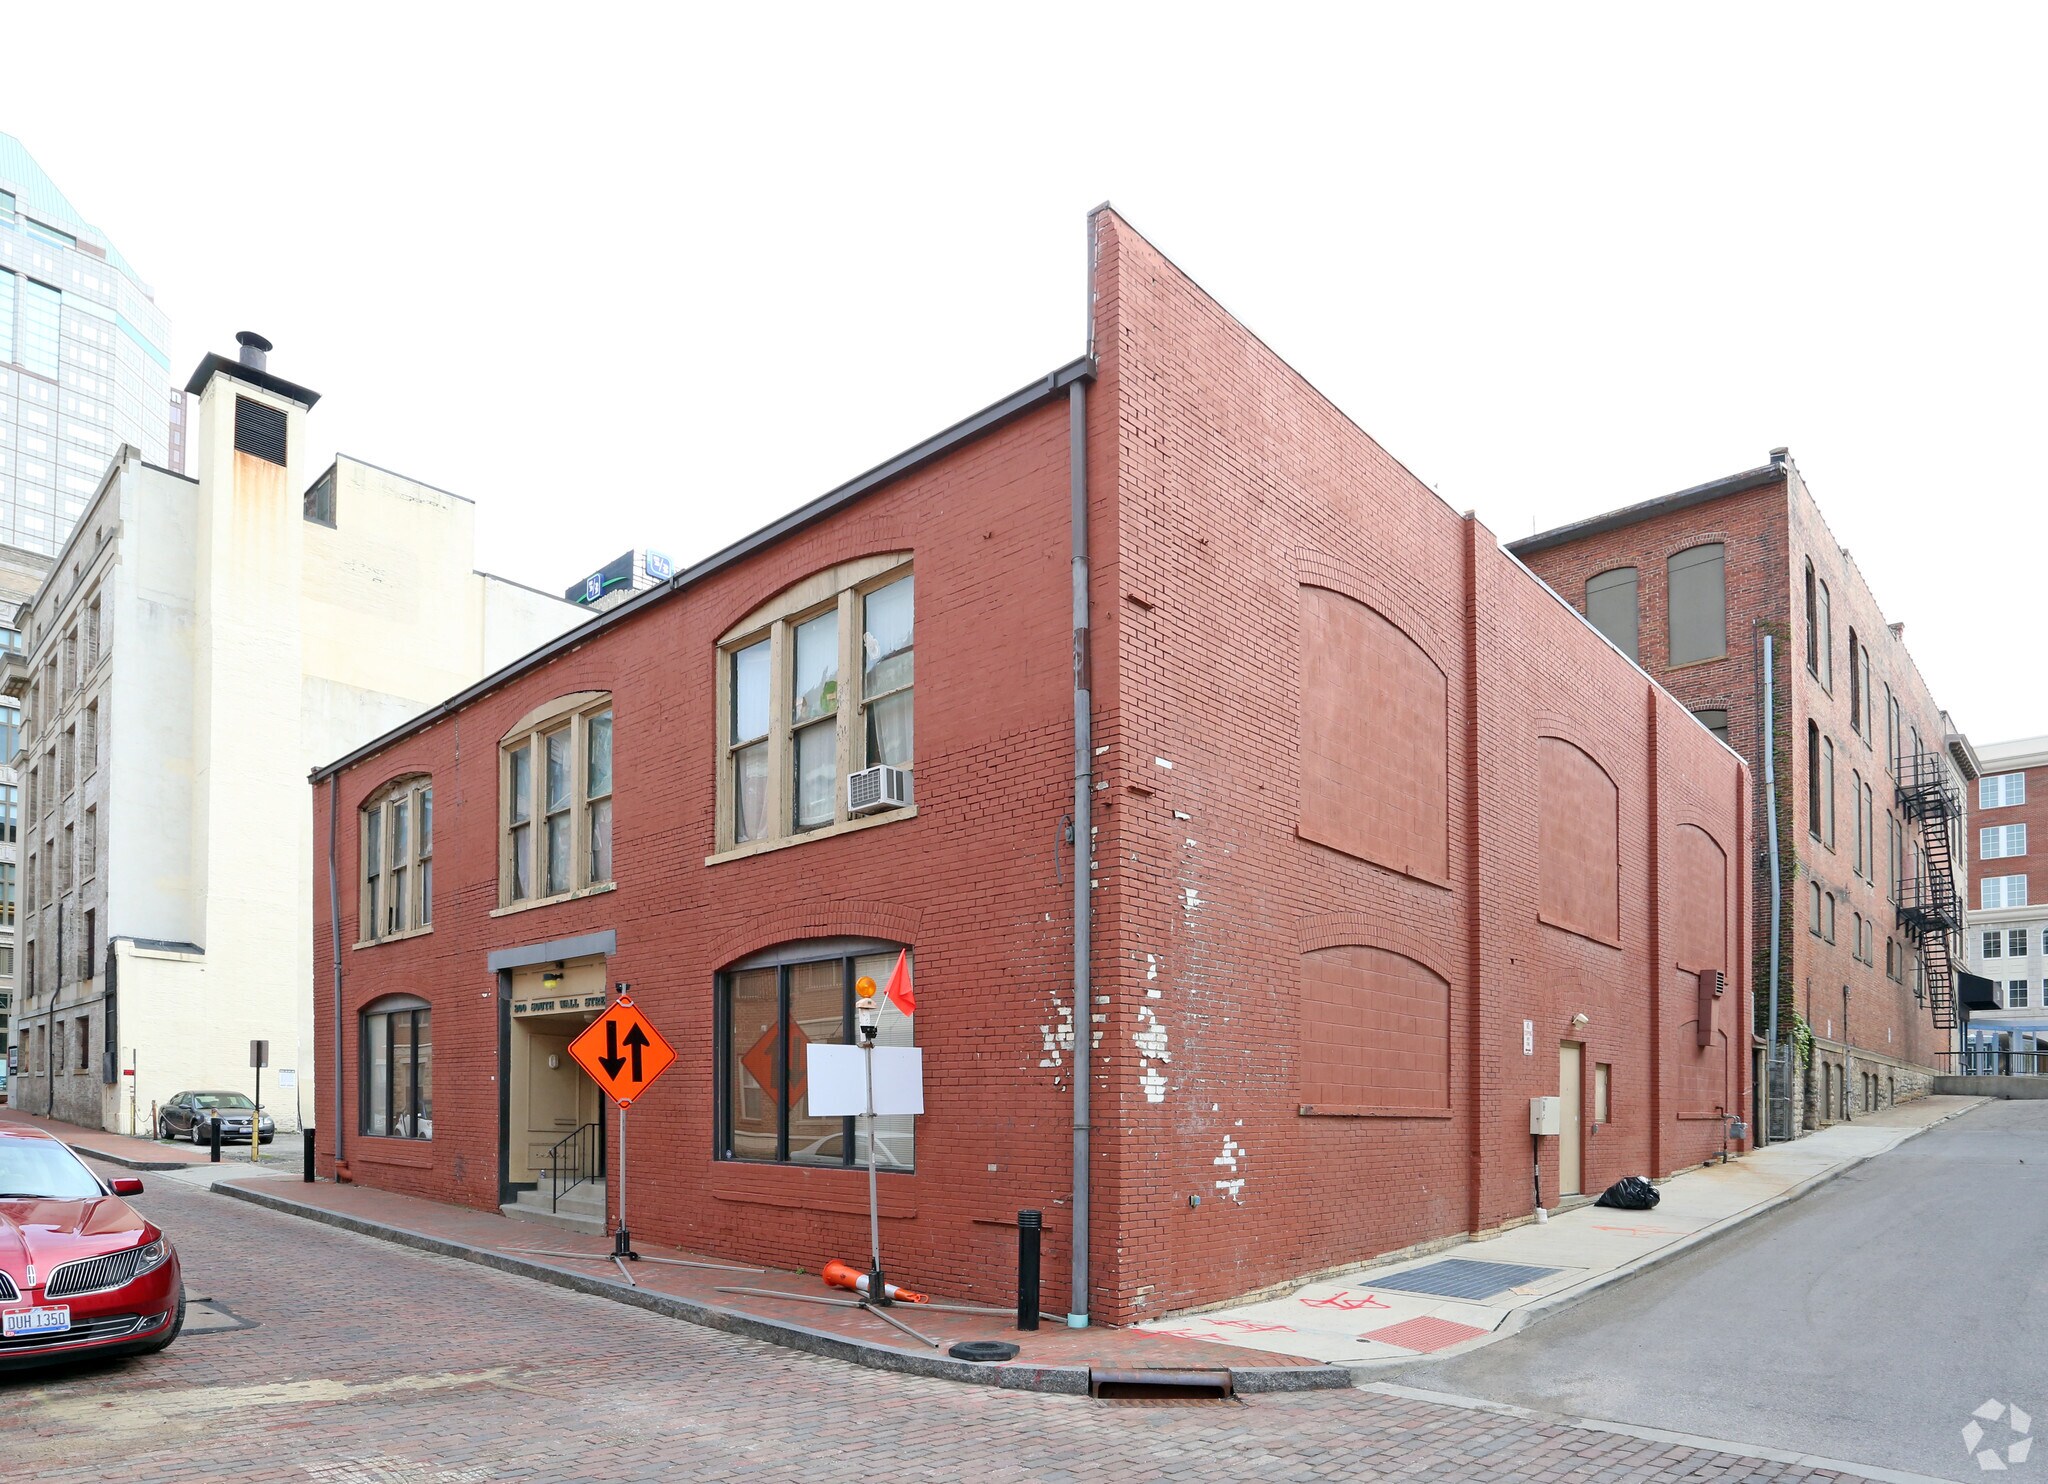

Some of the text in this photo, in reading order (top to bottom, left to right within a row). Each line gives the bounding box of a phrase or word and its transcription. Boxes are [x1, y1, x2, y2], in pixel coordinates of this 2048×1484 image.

[530, 1001, 555, 1011] SOUTH
[559, 999, 580, 1009] WALL
[8, 1312, 65, 1330] DUH 1350
